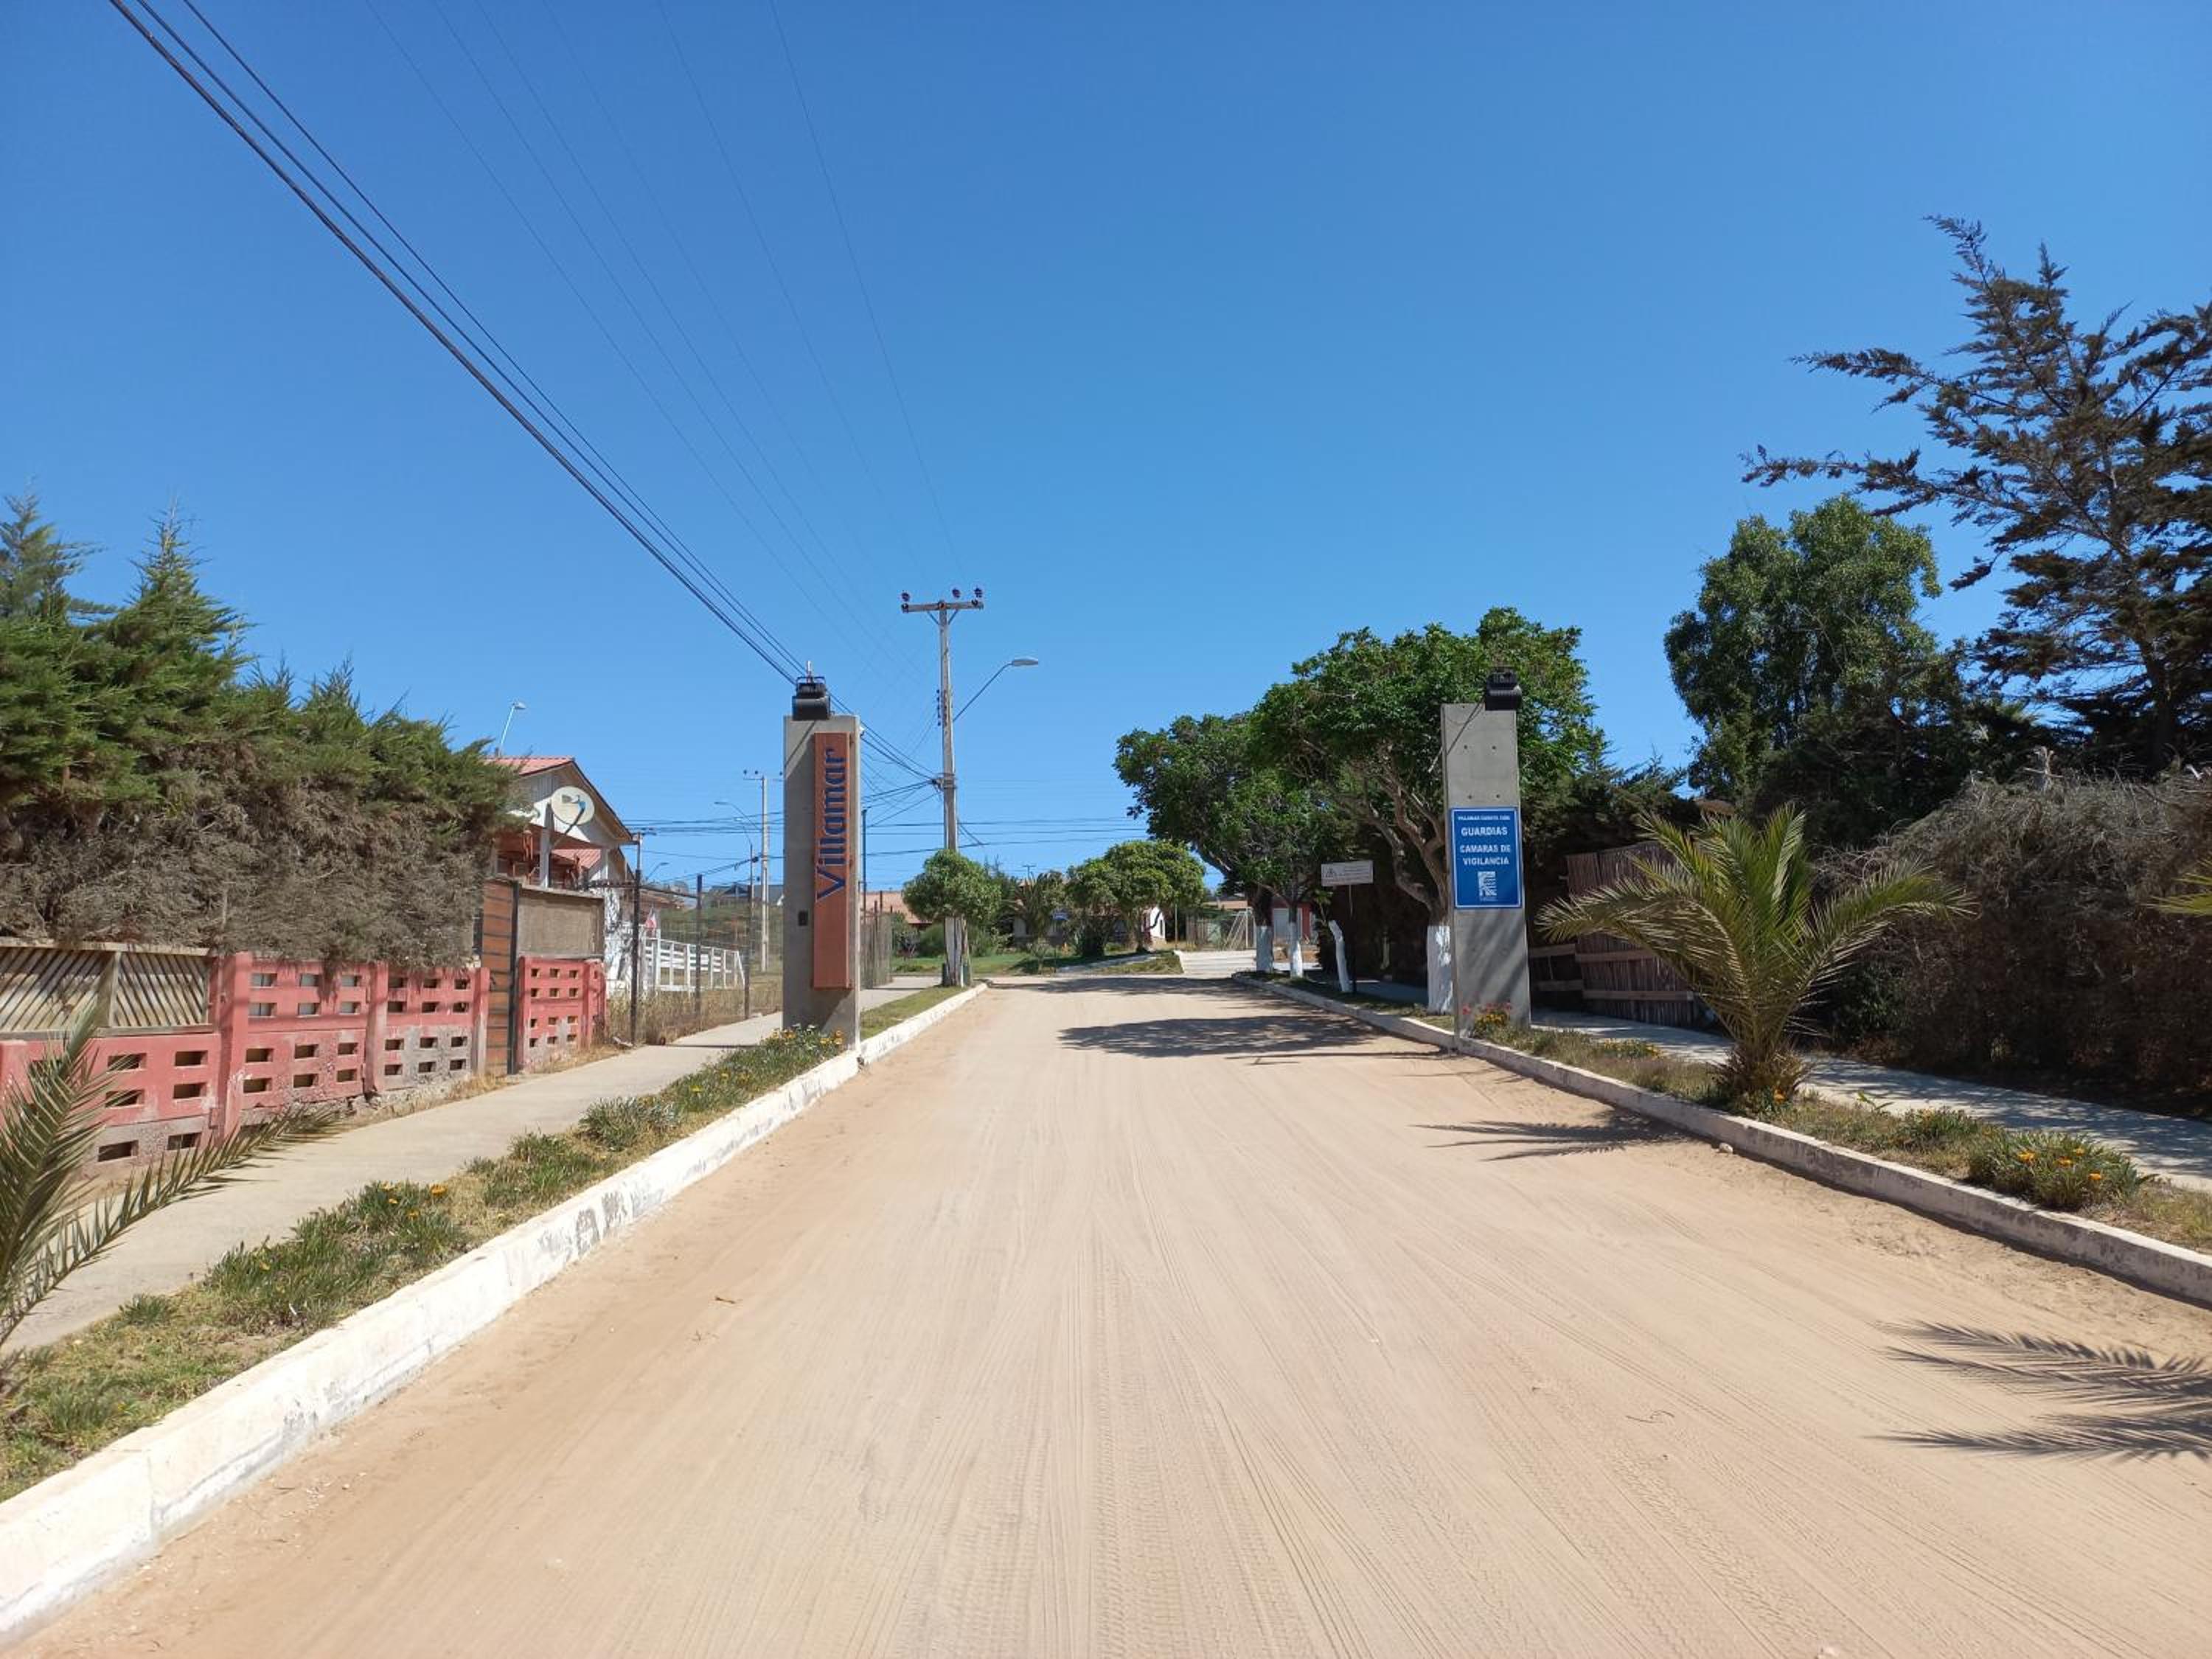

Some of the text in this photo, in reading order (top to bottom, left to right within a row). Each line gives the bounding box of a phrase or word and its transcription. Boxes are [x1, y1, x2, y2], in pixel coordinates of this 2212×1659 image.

[816, 748, 846, 901] Villamar
[1461, 827, 1508, 836] GUARDIAS
[1460, 844, 1511, 853] CAMARAS DE
[1462, 856, 1510, 866] VIGILANCIA
